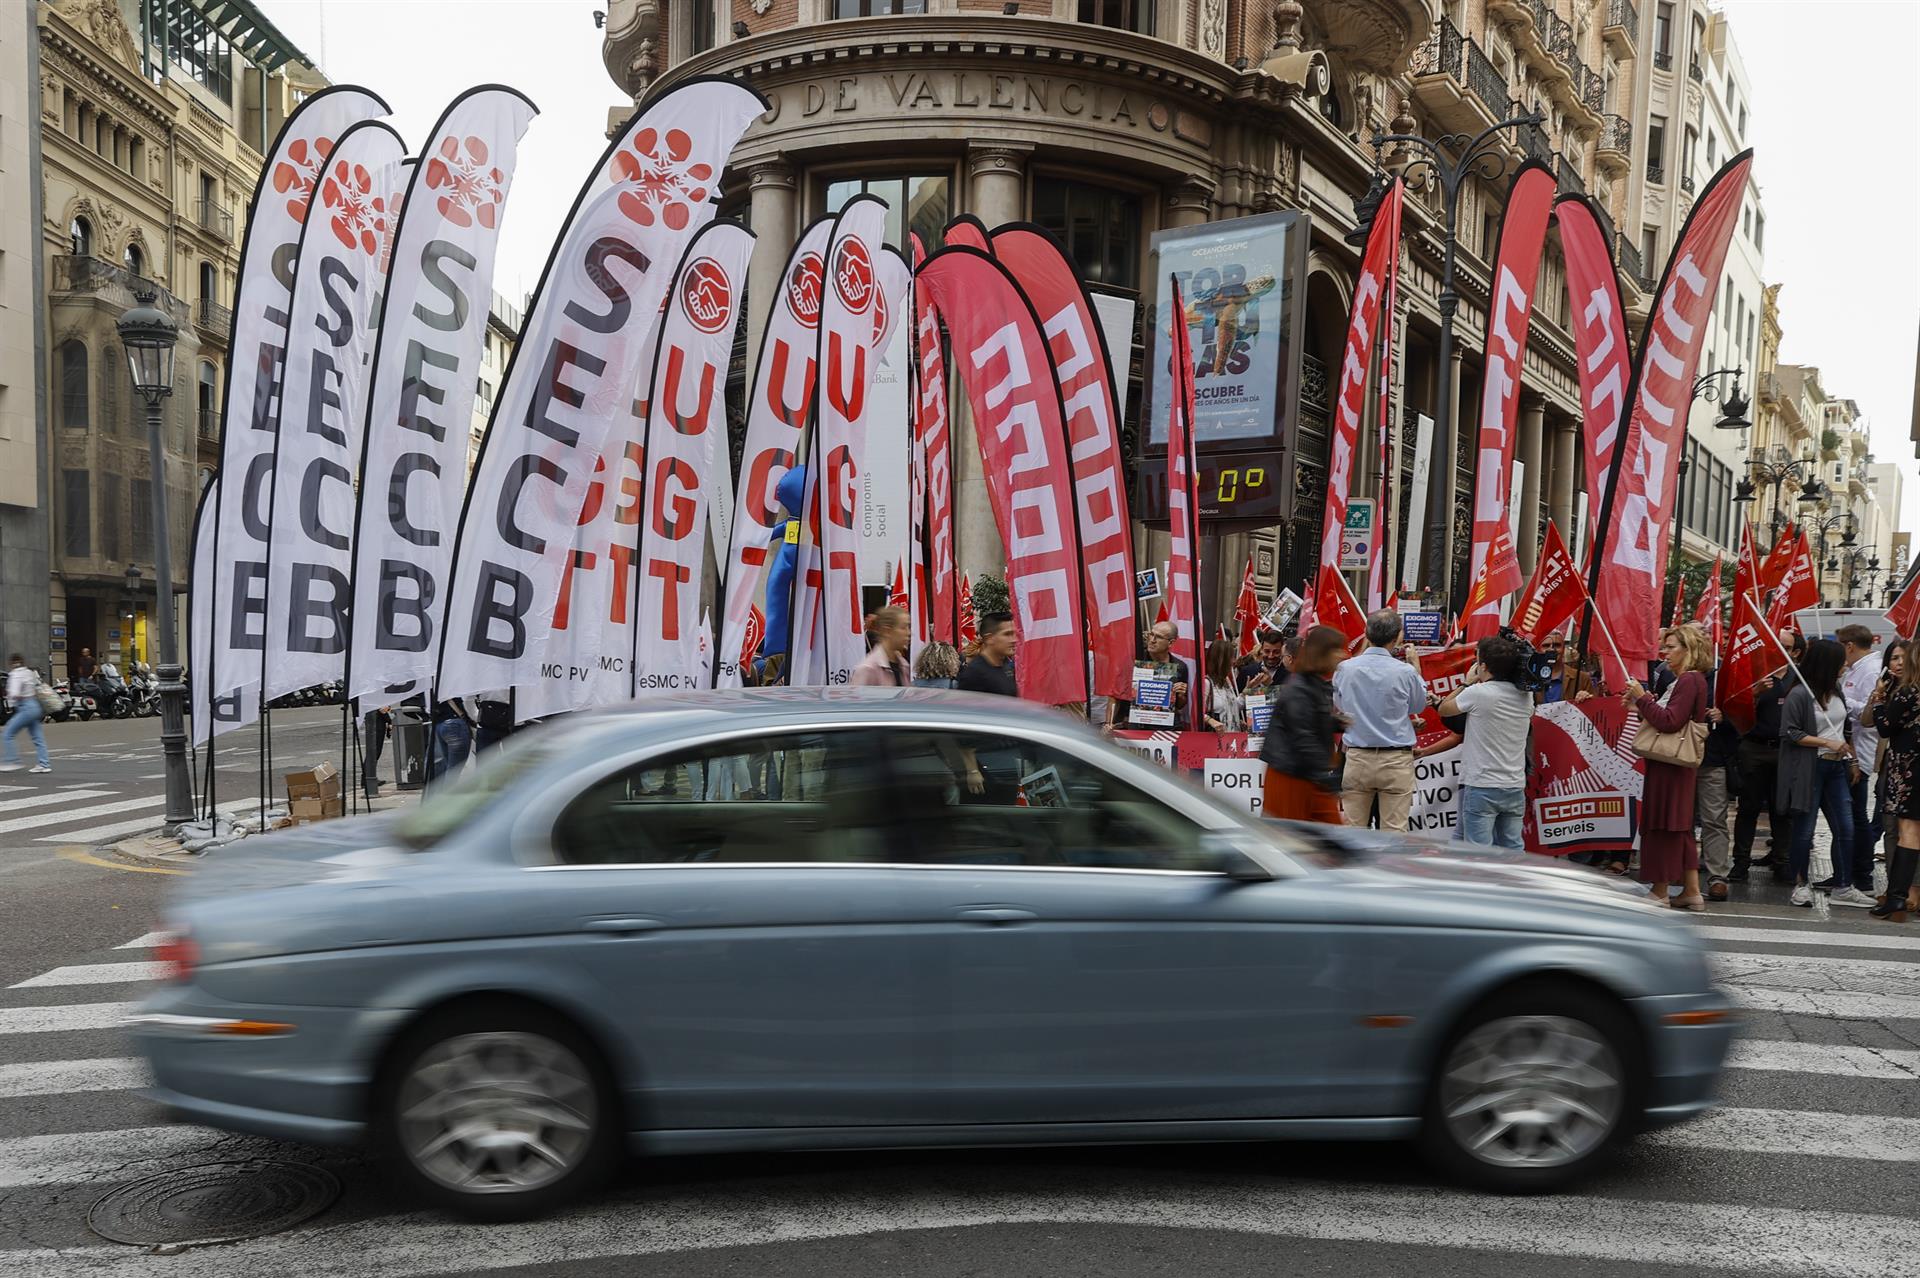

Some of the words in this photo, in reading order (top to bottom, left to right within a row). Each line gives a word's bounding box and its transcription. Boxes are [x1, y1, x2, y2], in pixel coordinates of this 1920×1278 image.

[803, 76, 858, 116] DE
[883, 72, 1136, 126] VALENCIA
[1195, 384, 1245, 400] SCUBRE
[375, 240, 477, 652] SECB
[467, 237, 651, 660] SECB
[648, 344, 716, 641] UGT
[877, 504, 887, 537] Social
[569, 667, 588, 681] PV
[1140, 682, 1168, 690] EXIGIMOS
[1211, 773, 1252, 788] POR
[1545, 801, 1596, 819] CCOO
[1543, 821, 1595, 838] serveis
